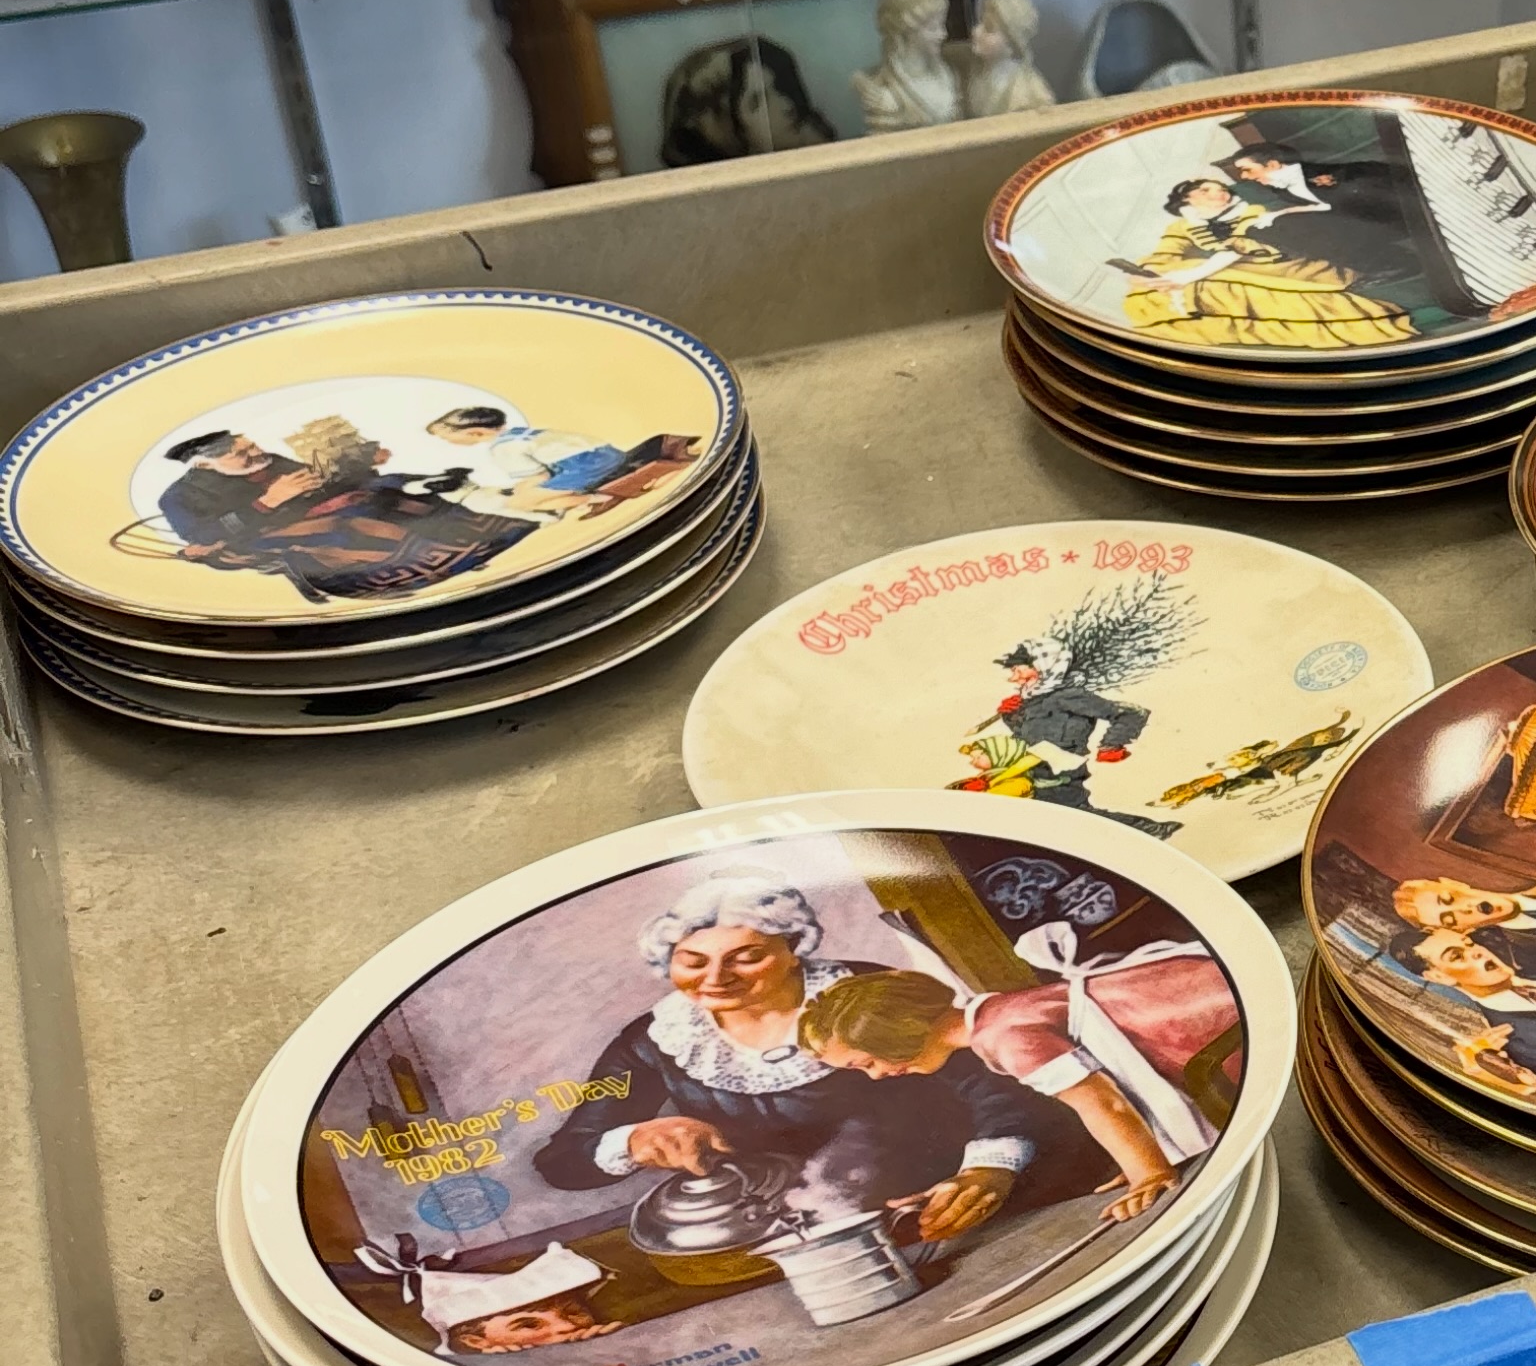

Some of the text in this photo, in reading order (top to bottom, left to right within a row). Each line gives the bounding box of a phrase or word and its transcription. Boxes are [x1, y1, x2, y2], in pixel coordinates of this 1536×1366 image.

[799, 540, 1193, 655] Christmas 1993
[320, 1070, 633, 1160] Mother's Day
[384, 1139, 505, 1186] 1982
